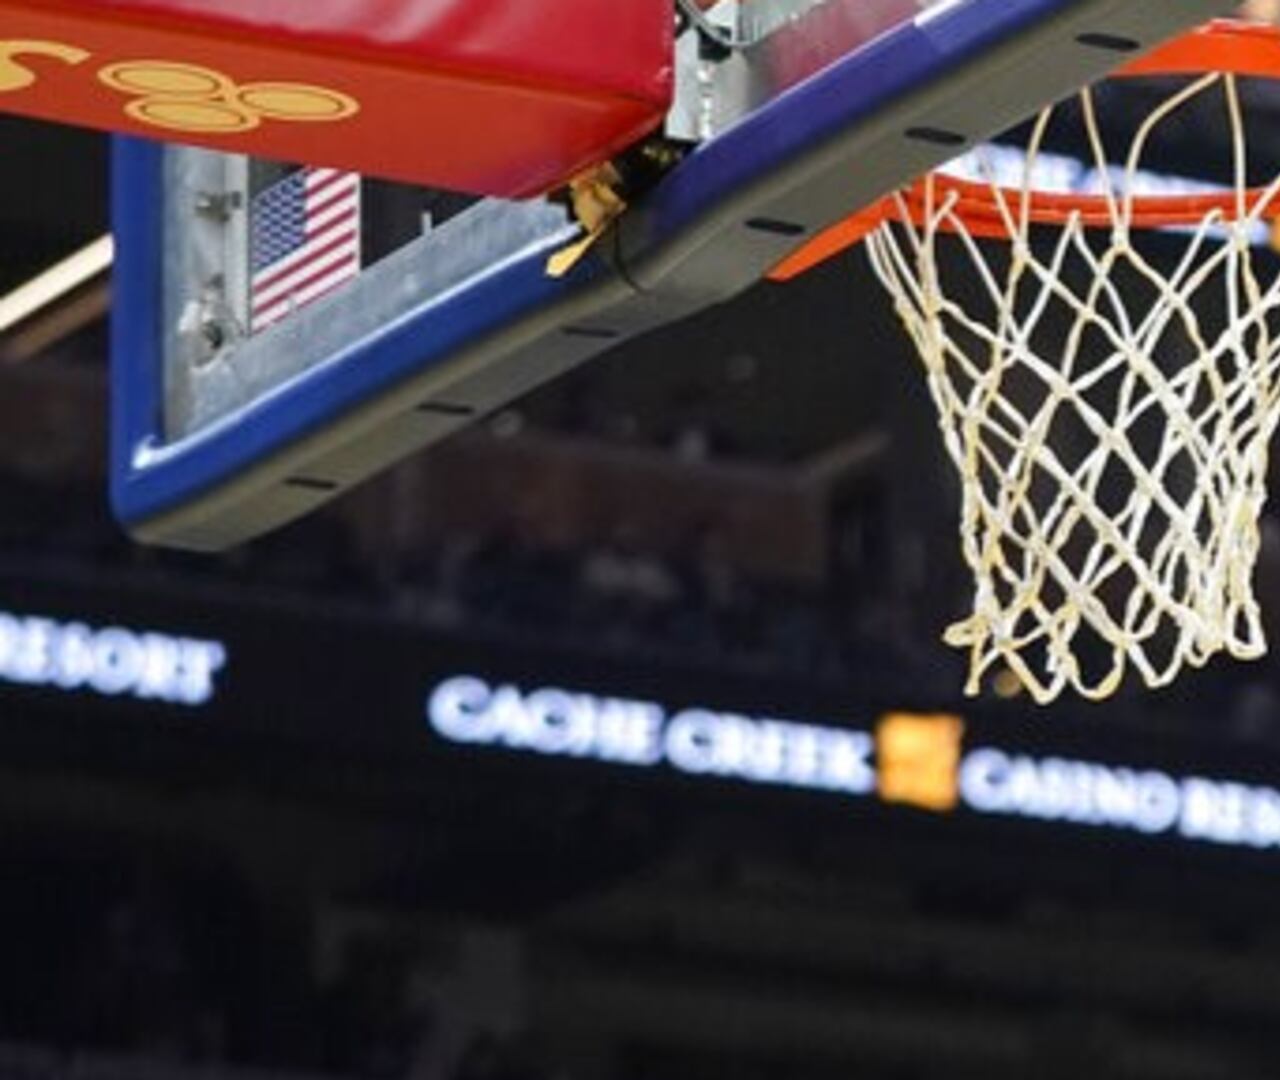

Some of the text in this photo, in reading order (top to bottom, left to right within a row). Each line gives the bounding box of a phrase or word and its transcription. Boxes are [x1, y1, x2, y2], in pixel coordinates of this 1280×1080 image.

[429, 676, 664, 765] CACHE
[665, 709, 876, 793] CREEK
[960, 748, 1178, 833] CASINO
